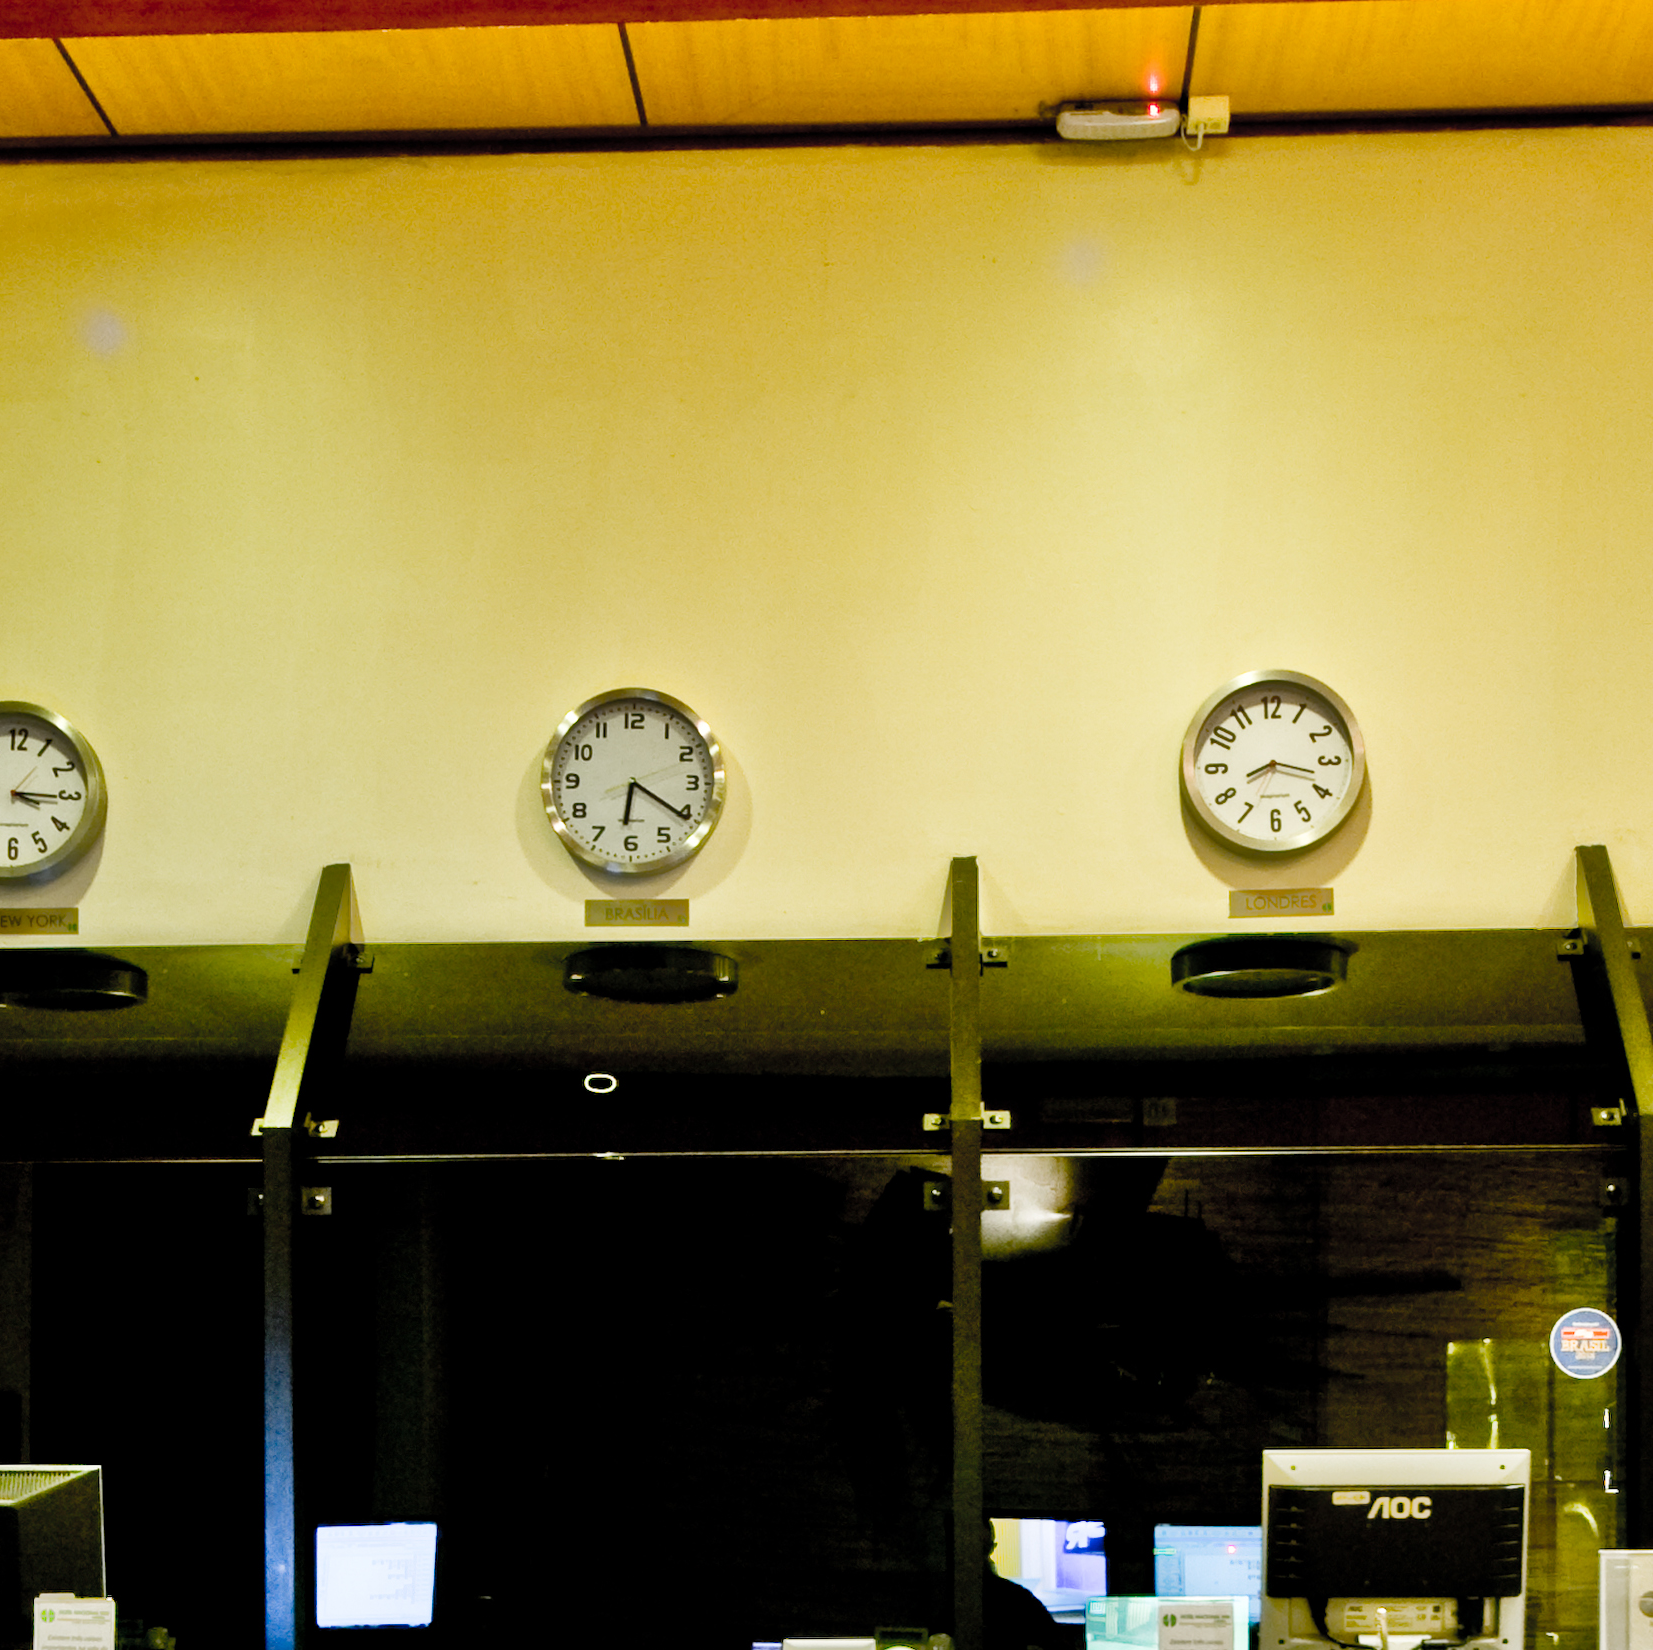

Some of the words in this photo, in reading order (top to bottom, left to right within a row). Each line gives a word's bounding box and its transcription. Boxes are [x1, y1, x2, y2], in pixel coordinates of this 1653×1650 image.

[1261, 696, 1281, 719] 12
[1293, 703, 1307, 723] 1
[624, 713, 645, 729] 12
[1230, 706, 1252, 729] 11
[596, 722, 607, 738] 11
[665, 723, 669, 739] 1
[1210, 725, 1236, 750] 10
[1309, 725, 1332, 743] 2
[10, 728, 29, 750] 12
[37, 739, 52, 756] 1
[575, 744, 592, 761] 10
[679, 746, 693, 762] 2
[1205, 763, 1228, 774] 9
[1318, 756, 1341, 765] 3
[52, 762, 74, 777] 2
[565, 773, 580, 788] 9
[686, 775, 699, 790] 3
[59, 790, 81, 801] 3
[1215, 787, 1236, 805] 8
[1313, 784, 1333, 799] 4
[572, 803, 587, 818] 8
[1238, 802, 1254, 823] 7
[1294, 801, 1311, 822] 5
[51, 816, 70, 832] 4
[1270, 809, 1281, 832] 6
[32, 831, 47, 852] 5
[592, 826, 605, 841] 7
[657, 827, 671, 843] 5
[8, 838, 18, 860] 6
[624, 836, 638, 851] 6
[1246, 895, 1317, 910] LONDRES
[27, 915, 66, 927] YORK
[1561, 1340, 1610, 1352] BRASIL
[1367, 1497, 1432, 1519] AOC
